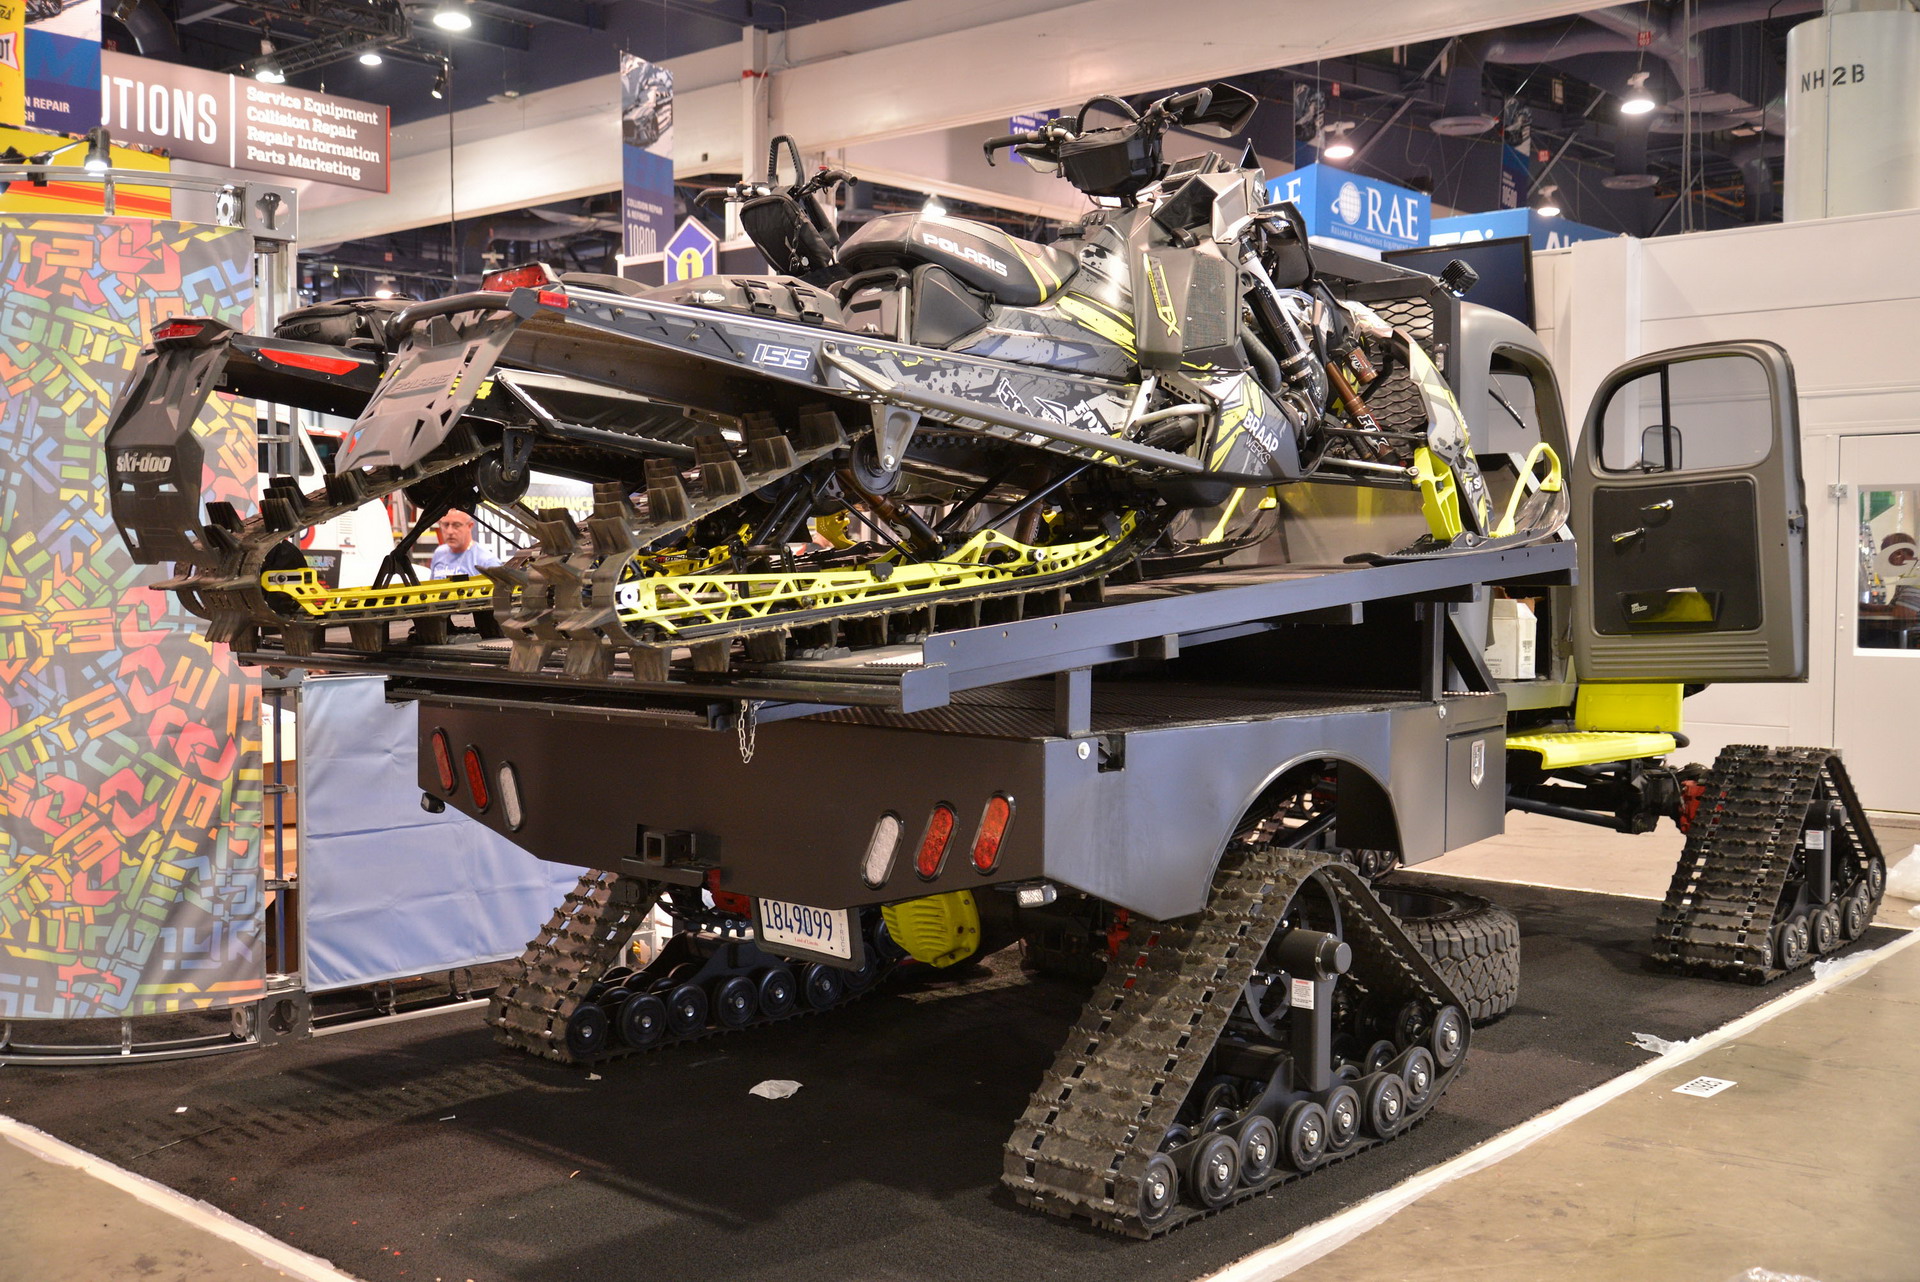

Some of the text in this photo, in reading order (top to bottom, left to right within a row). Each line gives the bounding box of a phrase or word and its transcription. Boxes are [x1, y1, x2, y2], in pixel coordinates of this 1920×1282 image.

[33, 97, 70, 113] REPAIR
[246, 86, 379, 125] Service Equipment
[246, 105, 358, 140] Collision Repair
[246, 126, 380, 163] Repair Information
[246, 146, 361, 181] Parts Marketing
[1366, 187, 1420, 241] RAE
[922, 232, 1008, 277] POLARIS
[752, 343, 811, 371] 155
[1242, 409, 1279, 453] BRAAP
[1246, 433, 1271, 465] WERKS
[116, 452, 172, 473] ski-doo
[763, 899, 832, 941] 1849099
